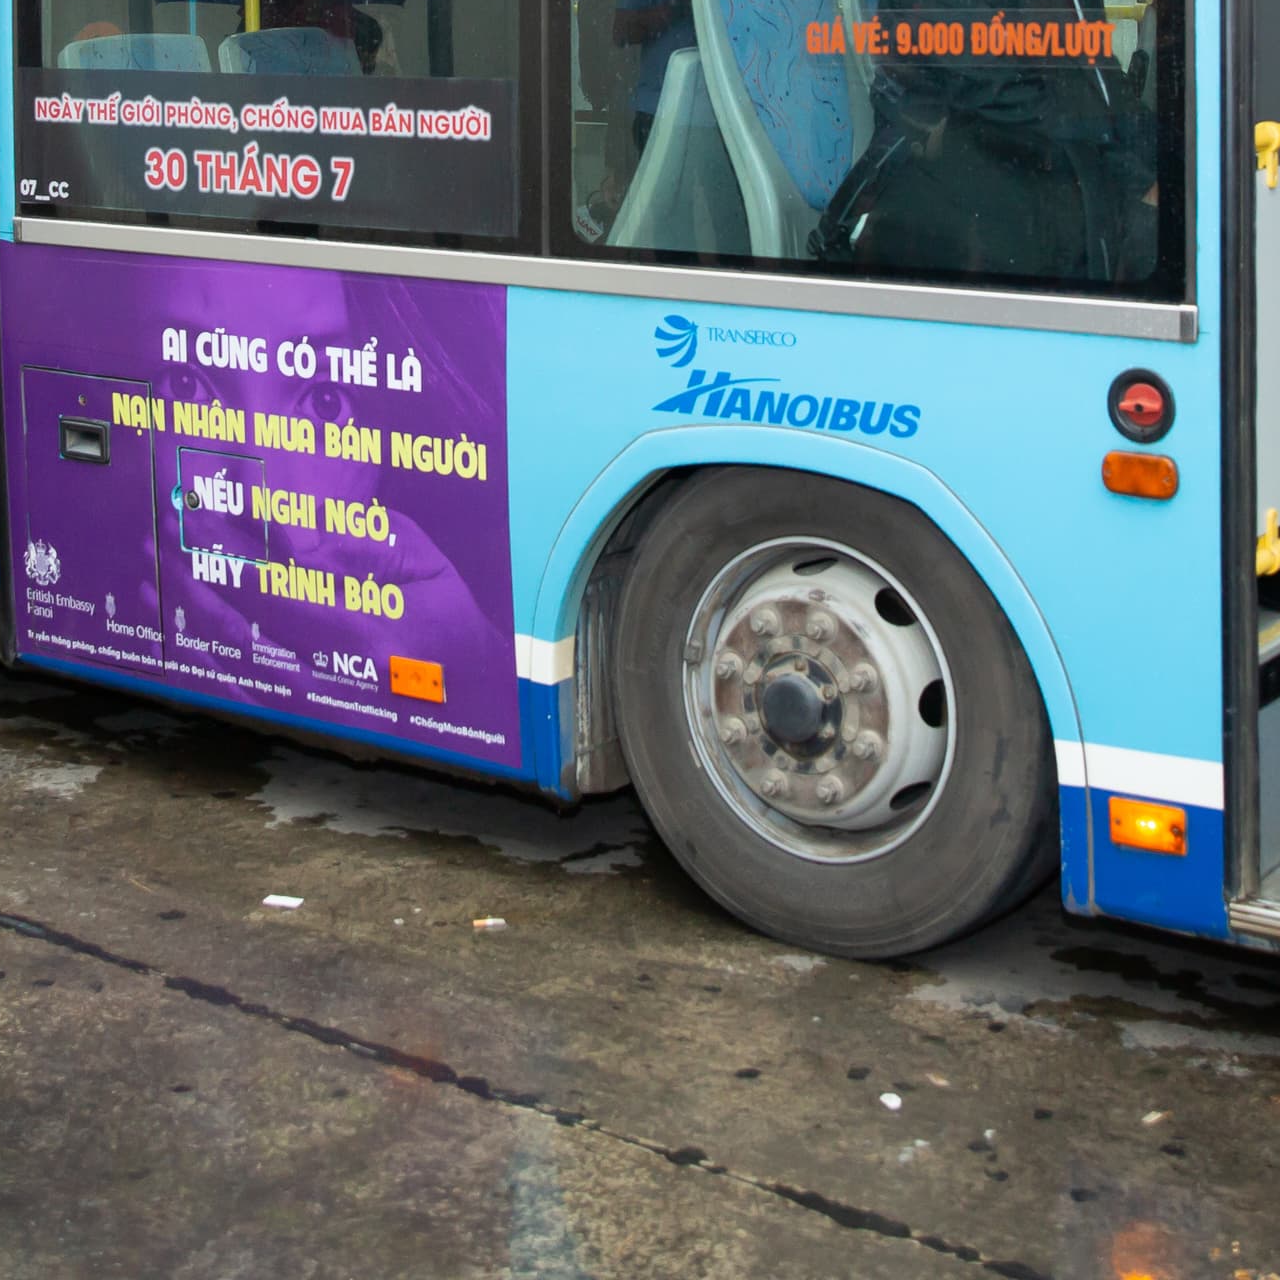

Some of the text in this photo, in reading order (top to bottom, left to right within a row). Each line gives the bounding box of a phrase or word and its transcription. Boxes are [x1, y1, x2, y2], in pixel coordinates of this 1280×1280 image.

[806, 10, 1116, 65] GIÁ VÉ: 9.000 ĐỒNG/LƯỢT
[36, 93, 490, 139] NGÀY THẾ GIỚI PHÒNG, CHỐNG MUA BÁN NGƯỜI
[145, 143, 354, 199] 30 THÁNG 7
[162, 327, 422, 393] AI CŨNG CÓ THỂ LÀ
[706, 326, 797, 348] TRANSERCO
[651, 370, 921, 438] HANOIBUS
[112, 392, 487, 482] NẠN NHÂN MUA BÁN NGƯỜI
[193, 468, 397, 547] NẾU NGHI NGỜ,
[56, 594, 95, 616] Embassy
[192, 544, 405, 620] HÃY TRÌNH BÁO
[106, 619, 165, 642] Home Office
[176, 633, 241, 659] Border Force
[252, 641, 296, 660] Immigration
[253, 653, 300, 672] Enforcement
[333, 651, 378, 682] NCA
